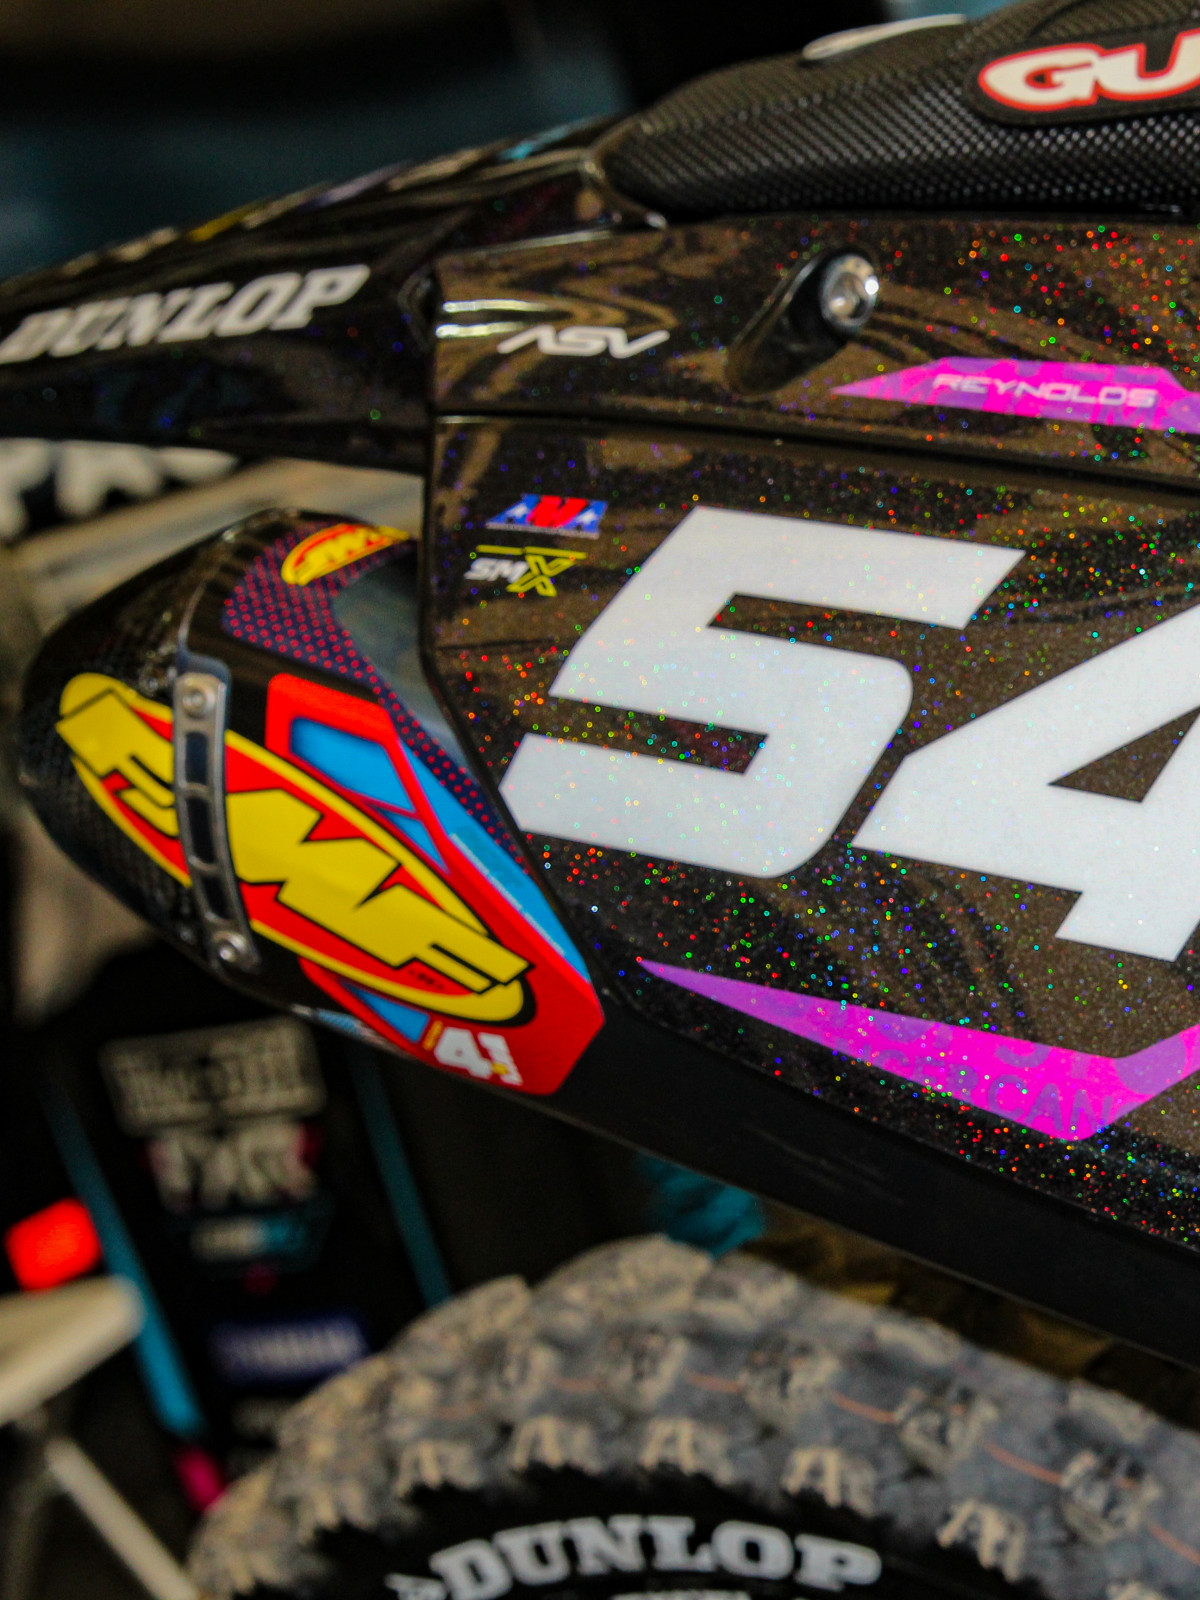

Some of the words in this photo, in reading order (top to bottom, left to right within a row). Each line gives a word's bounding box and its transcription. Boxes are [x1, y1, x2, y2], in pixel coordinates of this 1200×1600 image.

[0, 265, 370, 364] DUNLOP
[497, 324, 671, 359] ASV
[430, 1513, 882, 1600] DUNLOP
